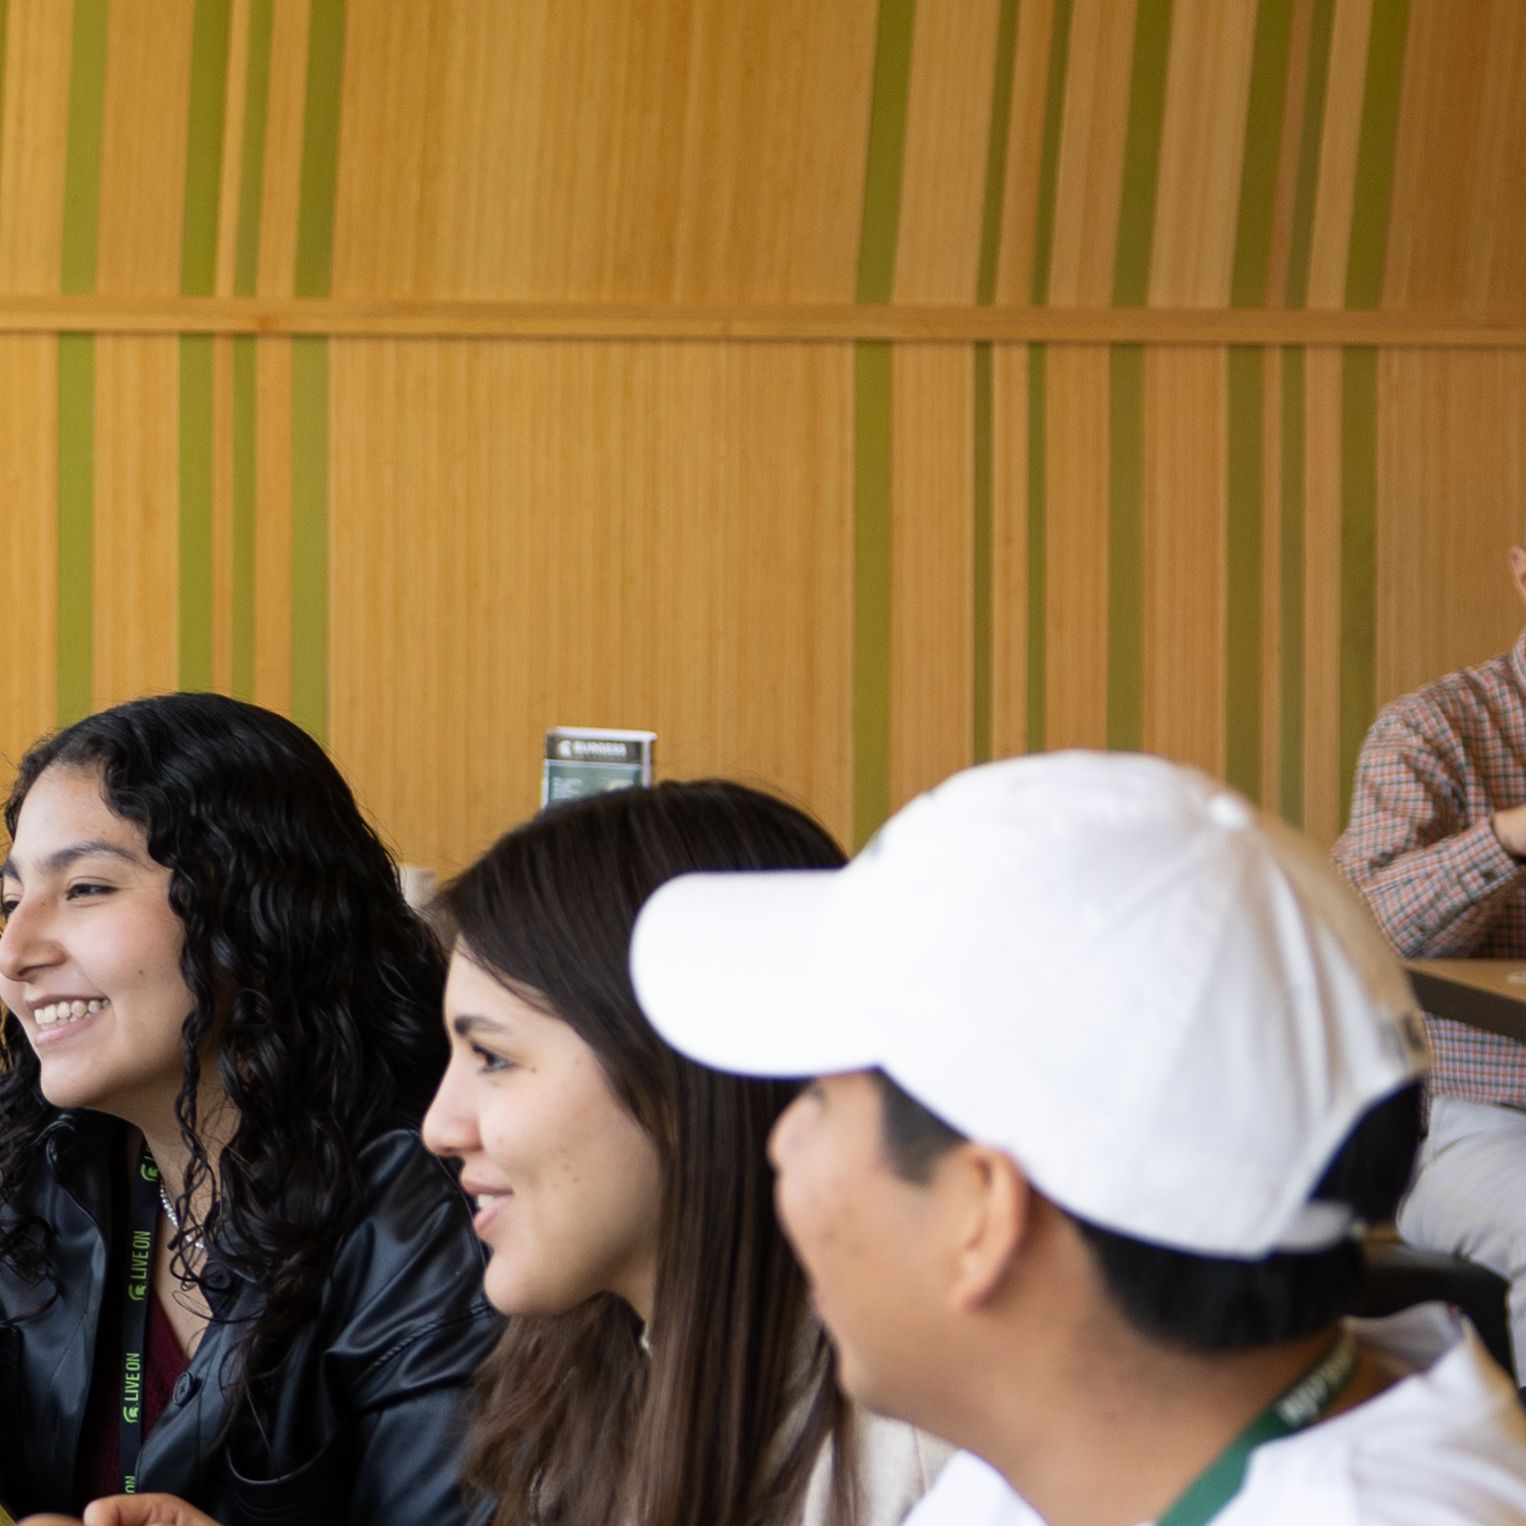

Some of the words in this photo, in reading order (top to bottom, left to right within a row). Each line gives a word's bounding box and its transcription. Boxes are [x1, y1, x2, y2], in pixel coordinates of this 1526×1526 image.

[133, 1230, 151, 1249] ON
[131, 1251, 149, 1279] LIVE
[126, 1352, 141, 1371] ON
[124, 1373, 141, 1402] LIVE
